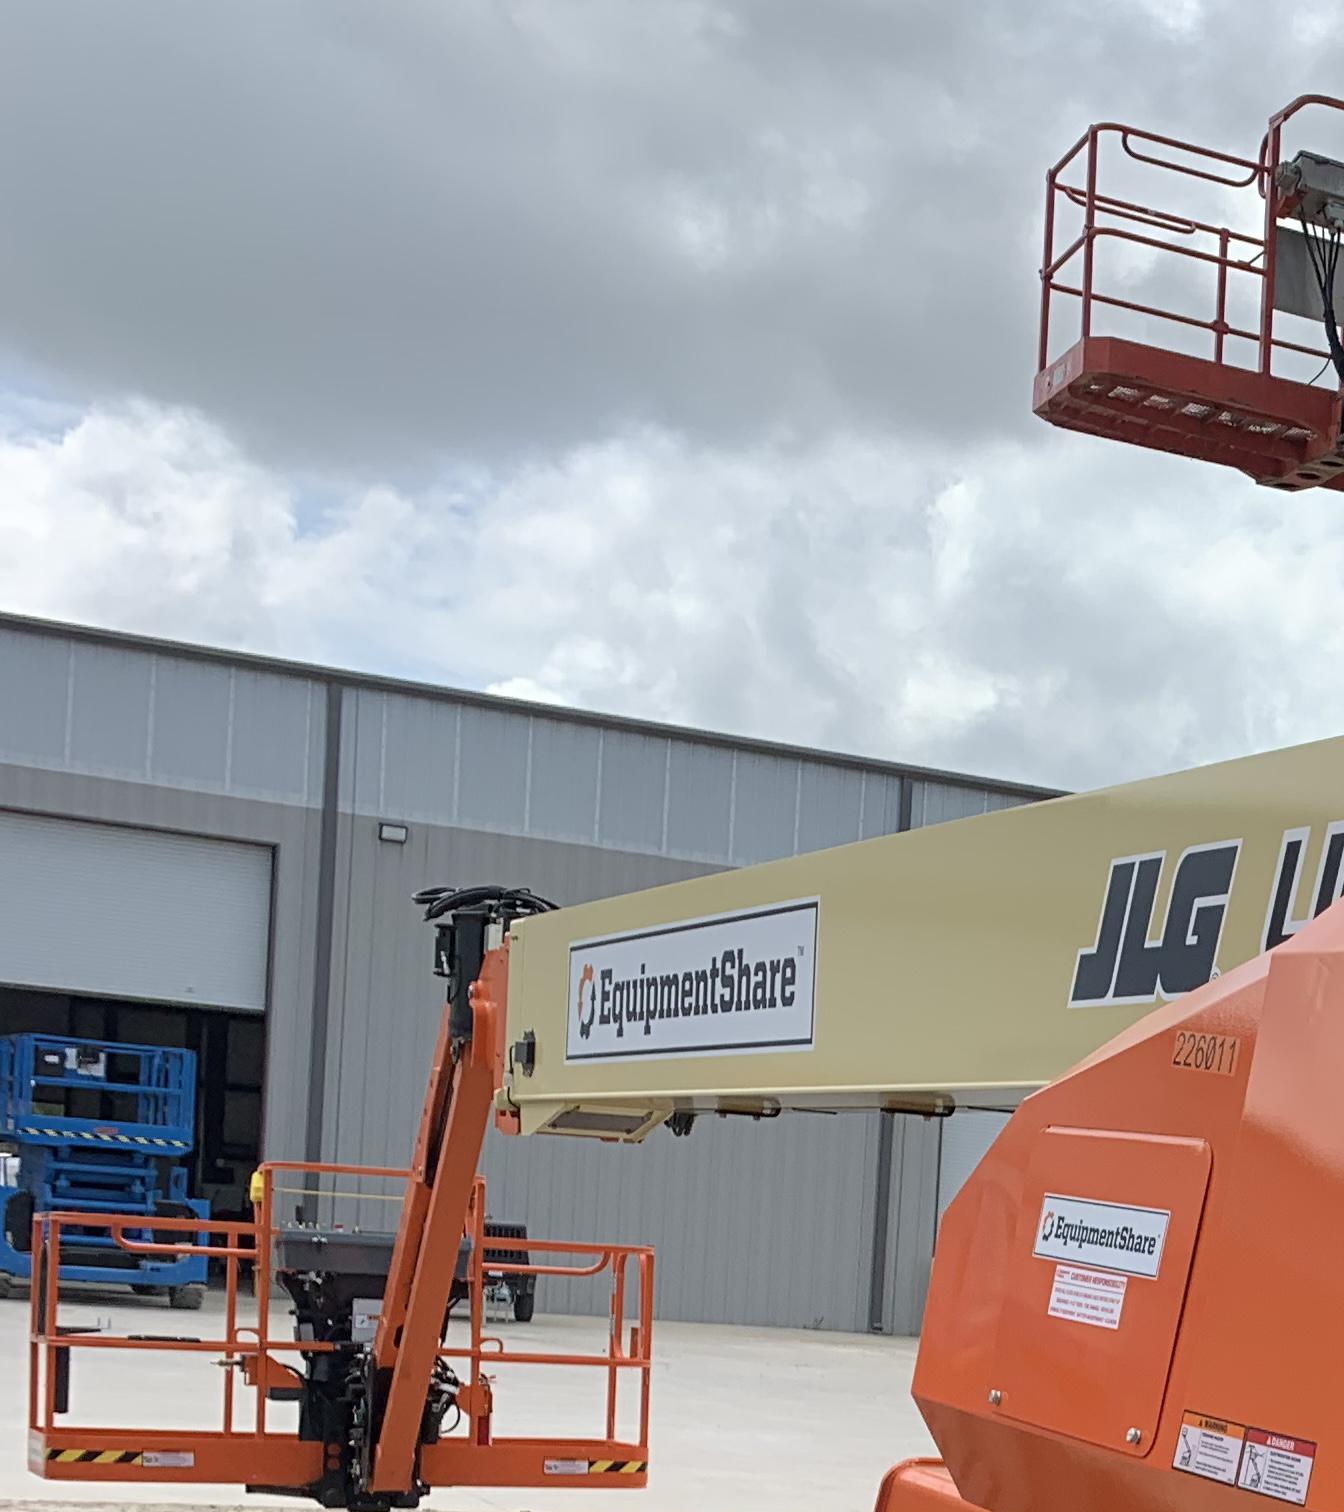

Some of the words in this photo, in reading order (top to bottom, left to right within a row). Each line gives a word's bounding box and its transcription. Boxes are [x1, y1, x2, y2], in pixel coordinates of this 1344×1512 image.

[1069, 839, 1242, 1007] JLG
[598, 947, 797, 1038] EquipmentShare
[1173, 1032, 1237, 1074] 226011
[1054, 1215, 1157, 1256] EquipmentShare
[1271, 1436, 1295, 1451] DANGER
